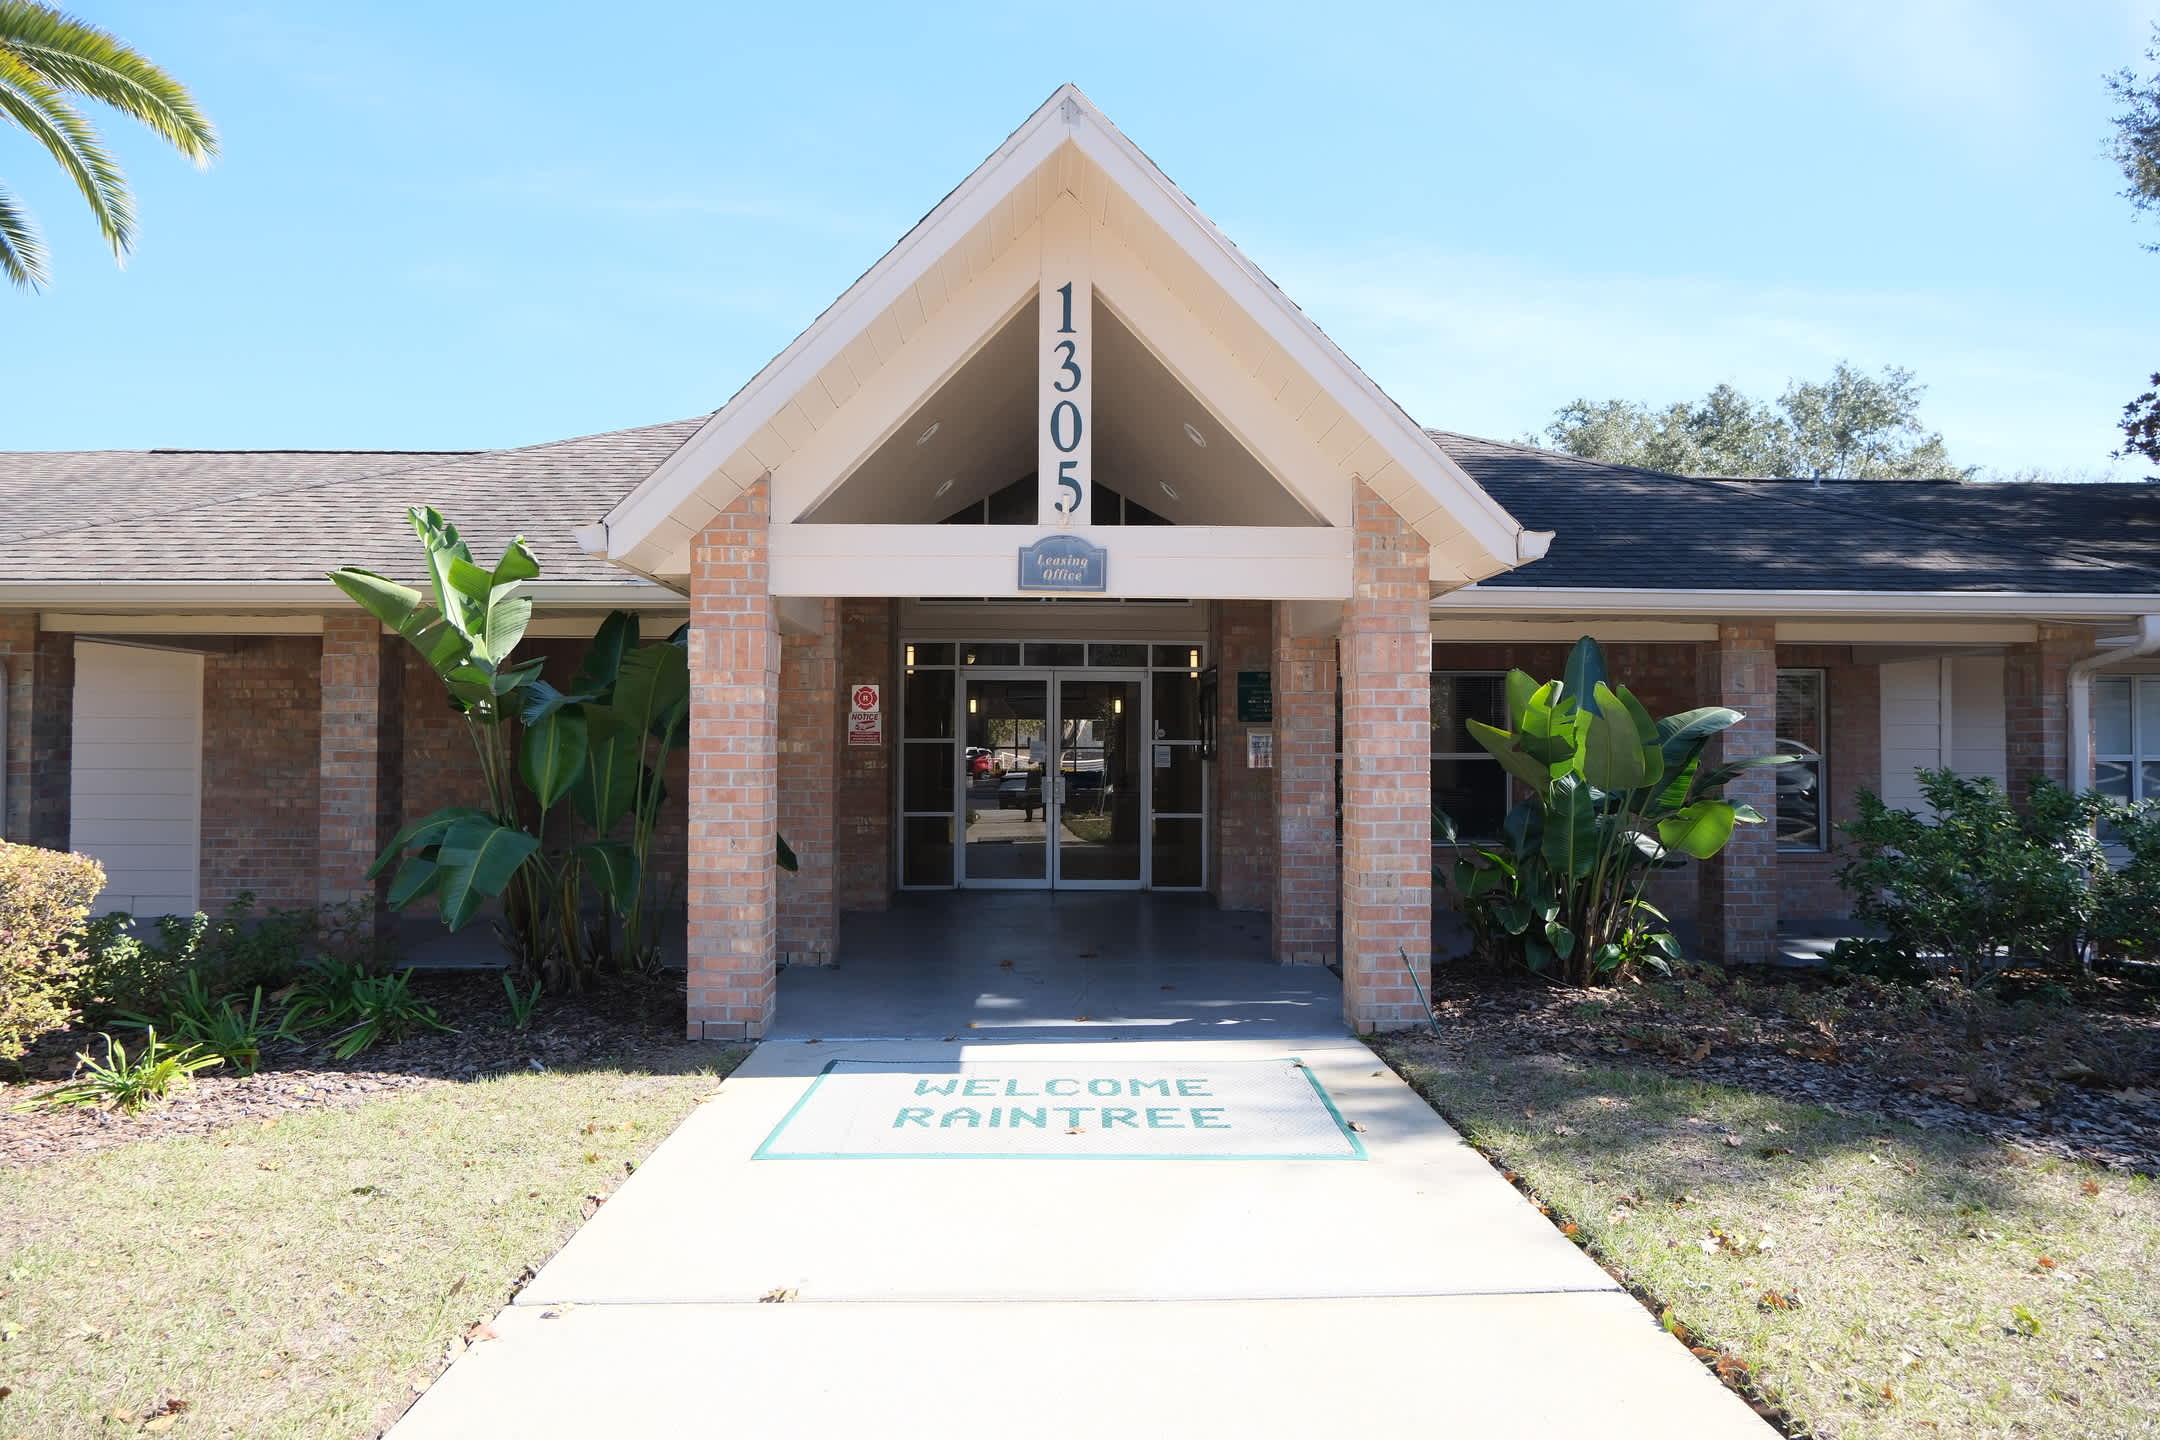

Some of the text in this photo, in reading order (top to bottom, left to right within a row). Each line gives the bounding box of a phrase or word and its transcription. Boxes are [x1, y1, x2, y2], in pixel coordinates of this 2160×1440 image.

[1050, 281, 1083, 513] 1305
[1037, 554, 1088, 568] Leasing
[1043, 568, 1082, 581] Office
[851, 713, 879, 721] NOTICE
[913, 1079, 1213, 1097] WELCOME
[892, 1107, 1232, 1129] RAINTREE
